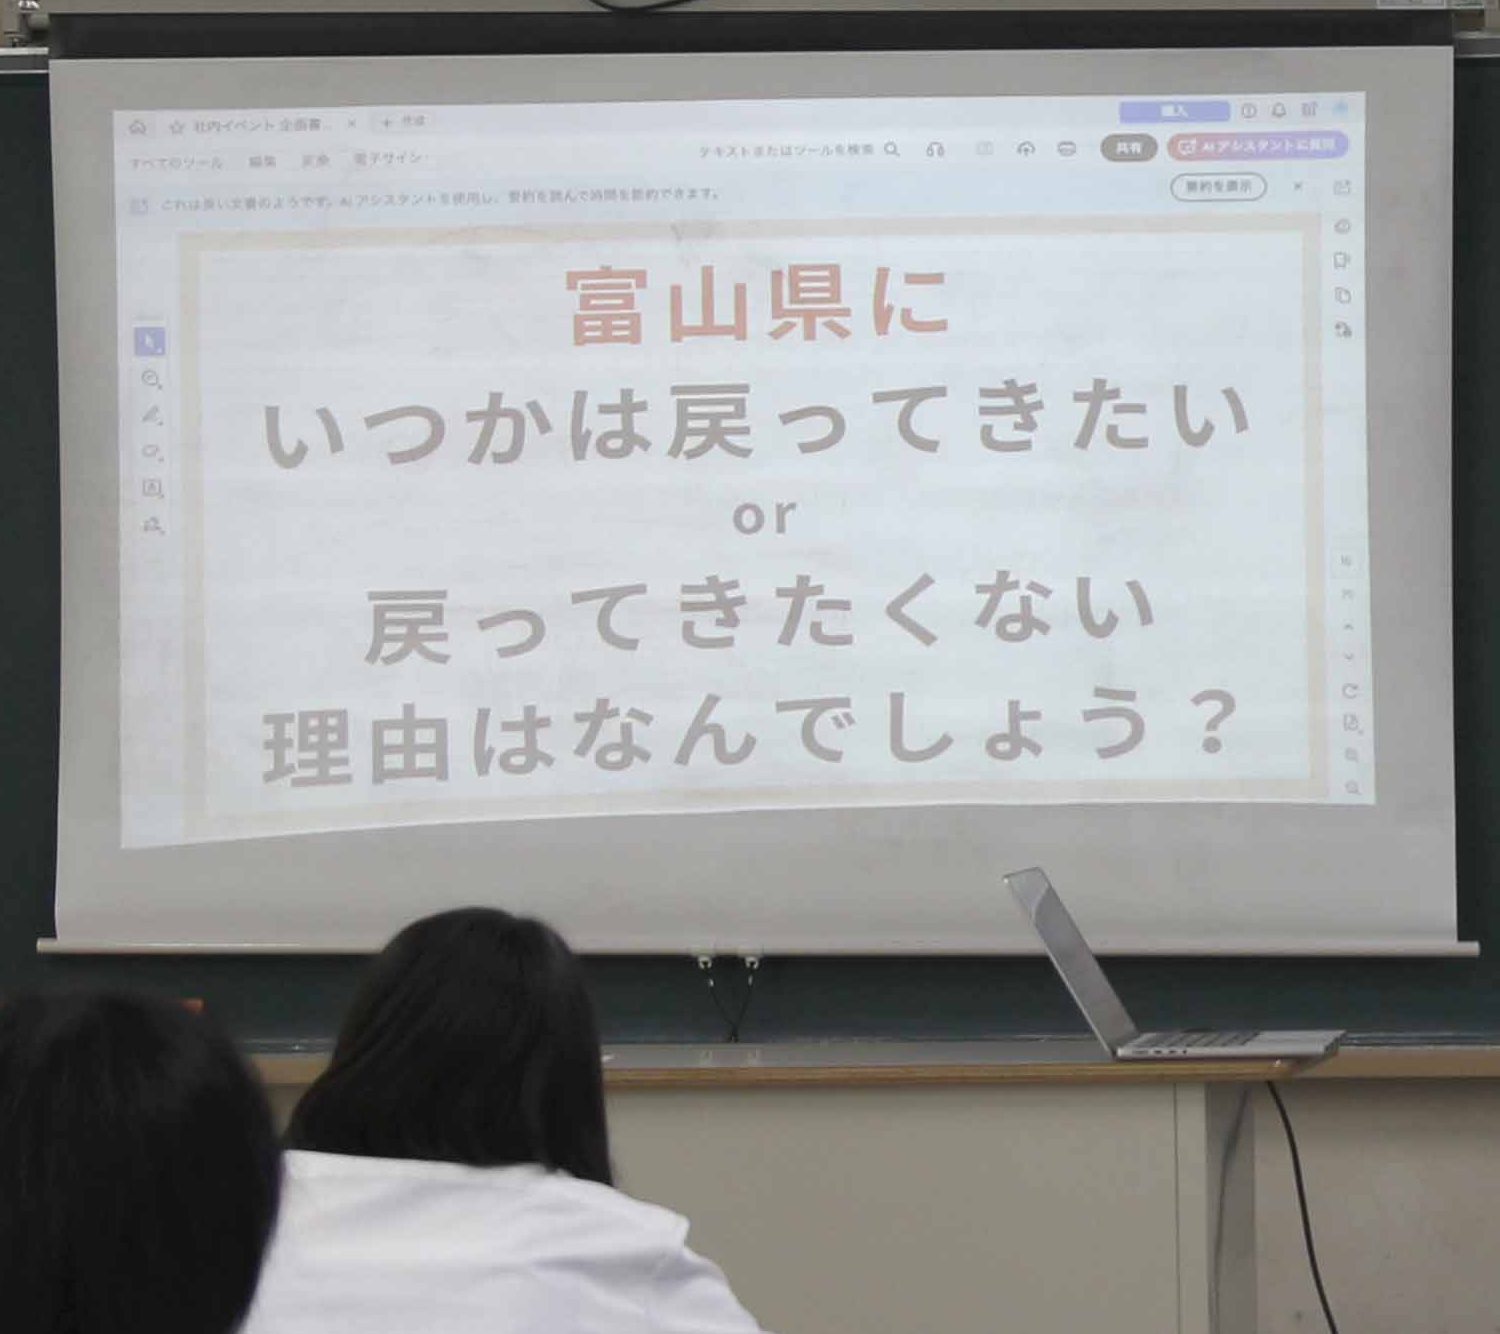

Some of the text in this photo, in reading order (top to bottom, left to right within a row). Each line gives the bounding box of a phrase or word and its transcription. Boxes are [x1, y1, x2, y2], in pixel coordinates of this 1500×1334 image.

[566, 262, 950, 348] 富山県に
[262, 375, 1252, 471] いつかは戻ってきたい
[731, 495, 798, 538] or
[364, 567, 1155, 667] 戻ってきたくない
[262, 687, 1240, 790] 理由はなんでしょう?
